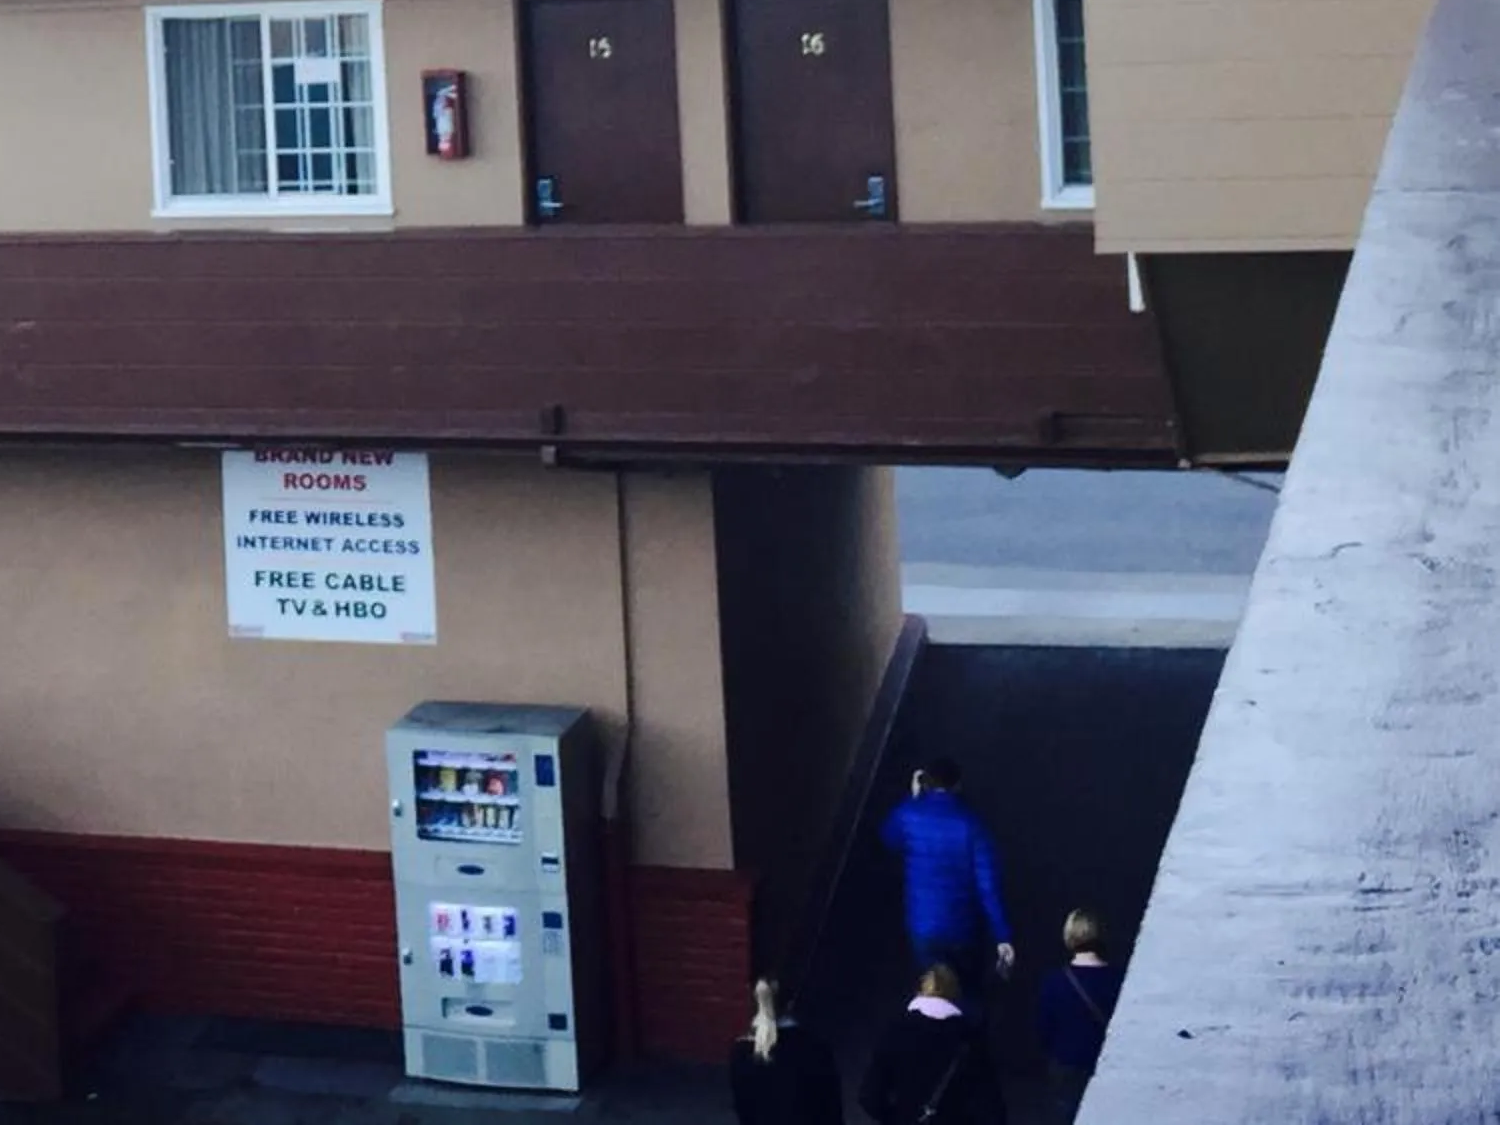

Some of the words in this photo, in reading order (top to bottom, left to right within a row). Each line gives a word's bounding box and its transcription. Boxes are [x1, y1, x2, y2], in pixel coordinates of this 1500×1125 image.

[283, 472, 368, 491] ROOMS
[249, 509, 298, 525] FREE
[304, 511, 405, 528] WIRELESS
[236, 535, 335, 552] INTERNET
[342, 538, 421, 555] ACCESS
[254, 570, 317, 589] FREE
[325, 572, 407, 593] CABLE
[276, 598, 307, 617] TV
[335, 601, 388, 620] HBO
